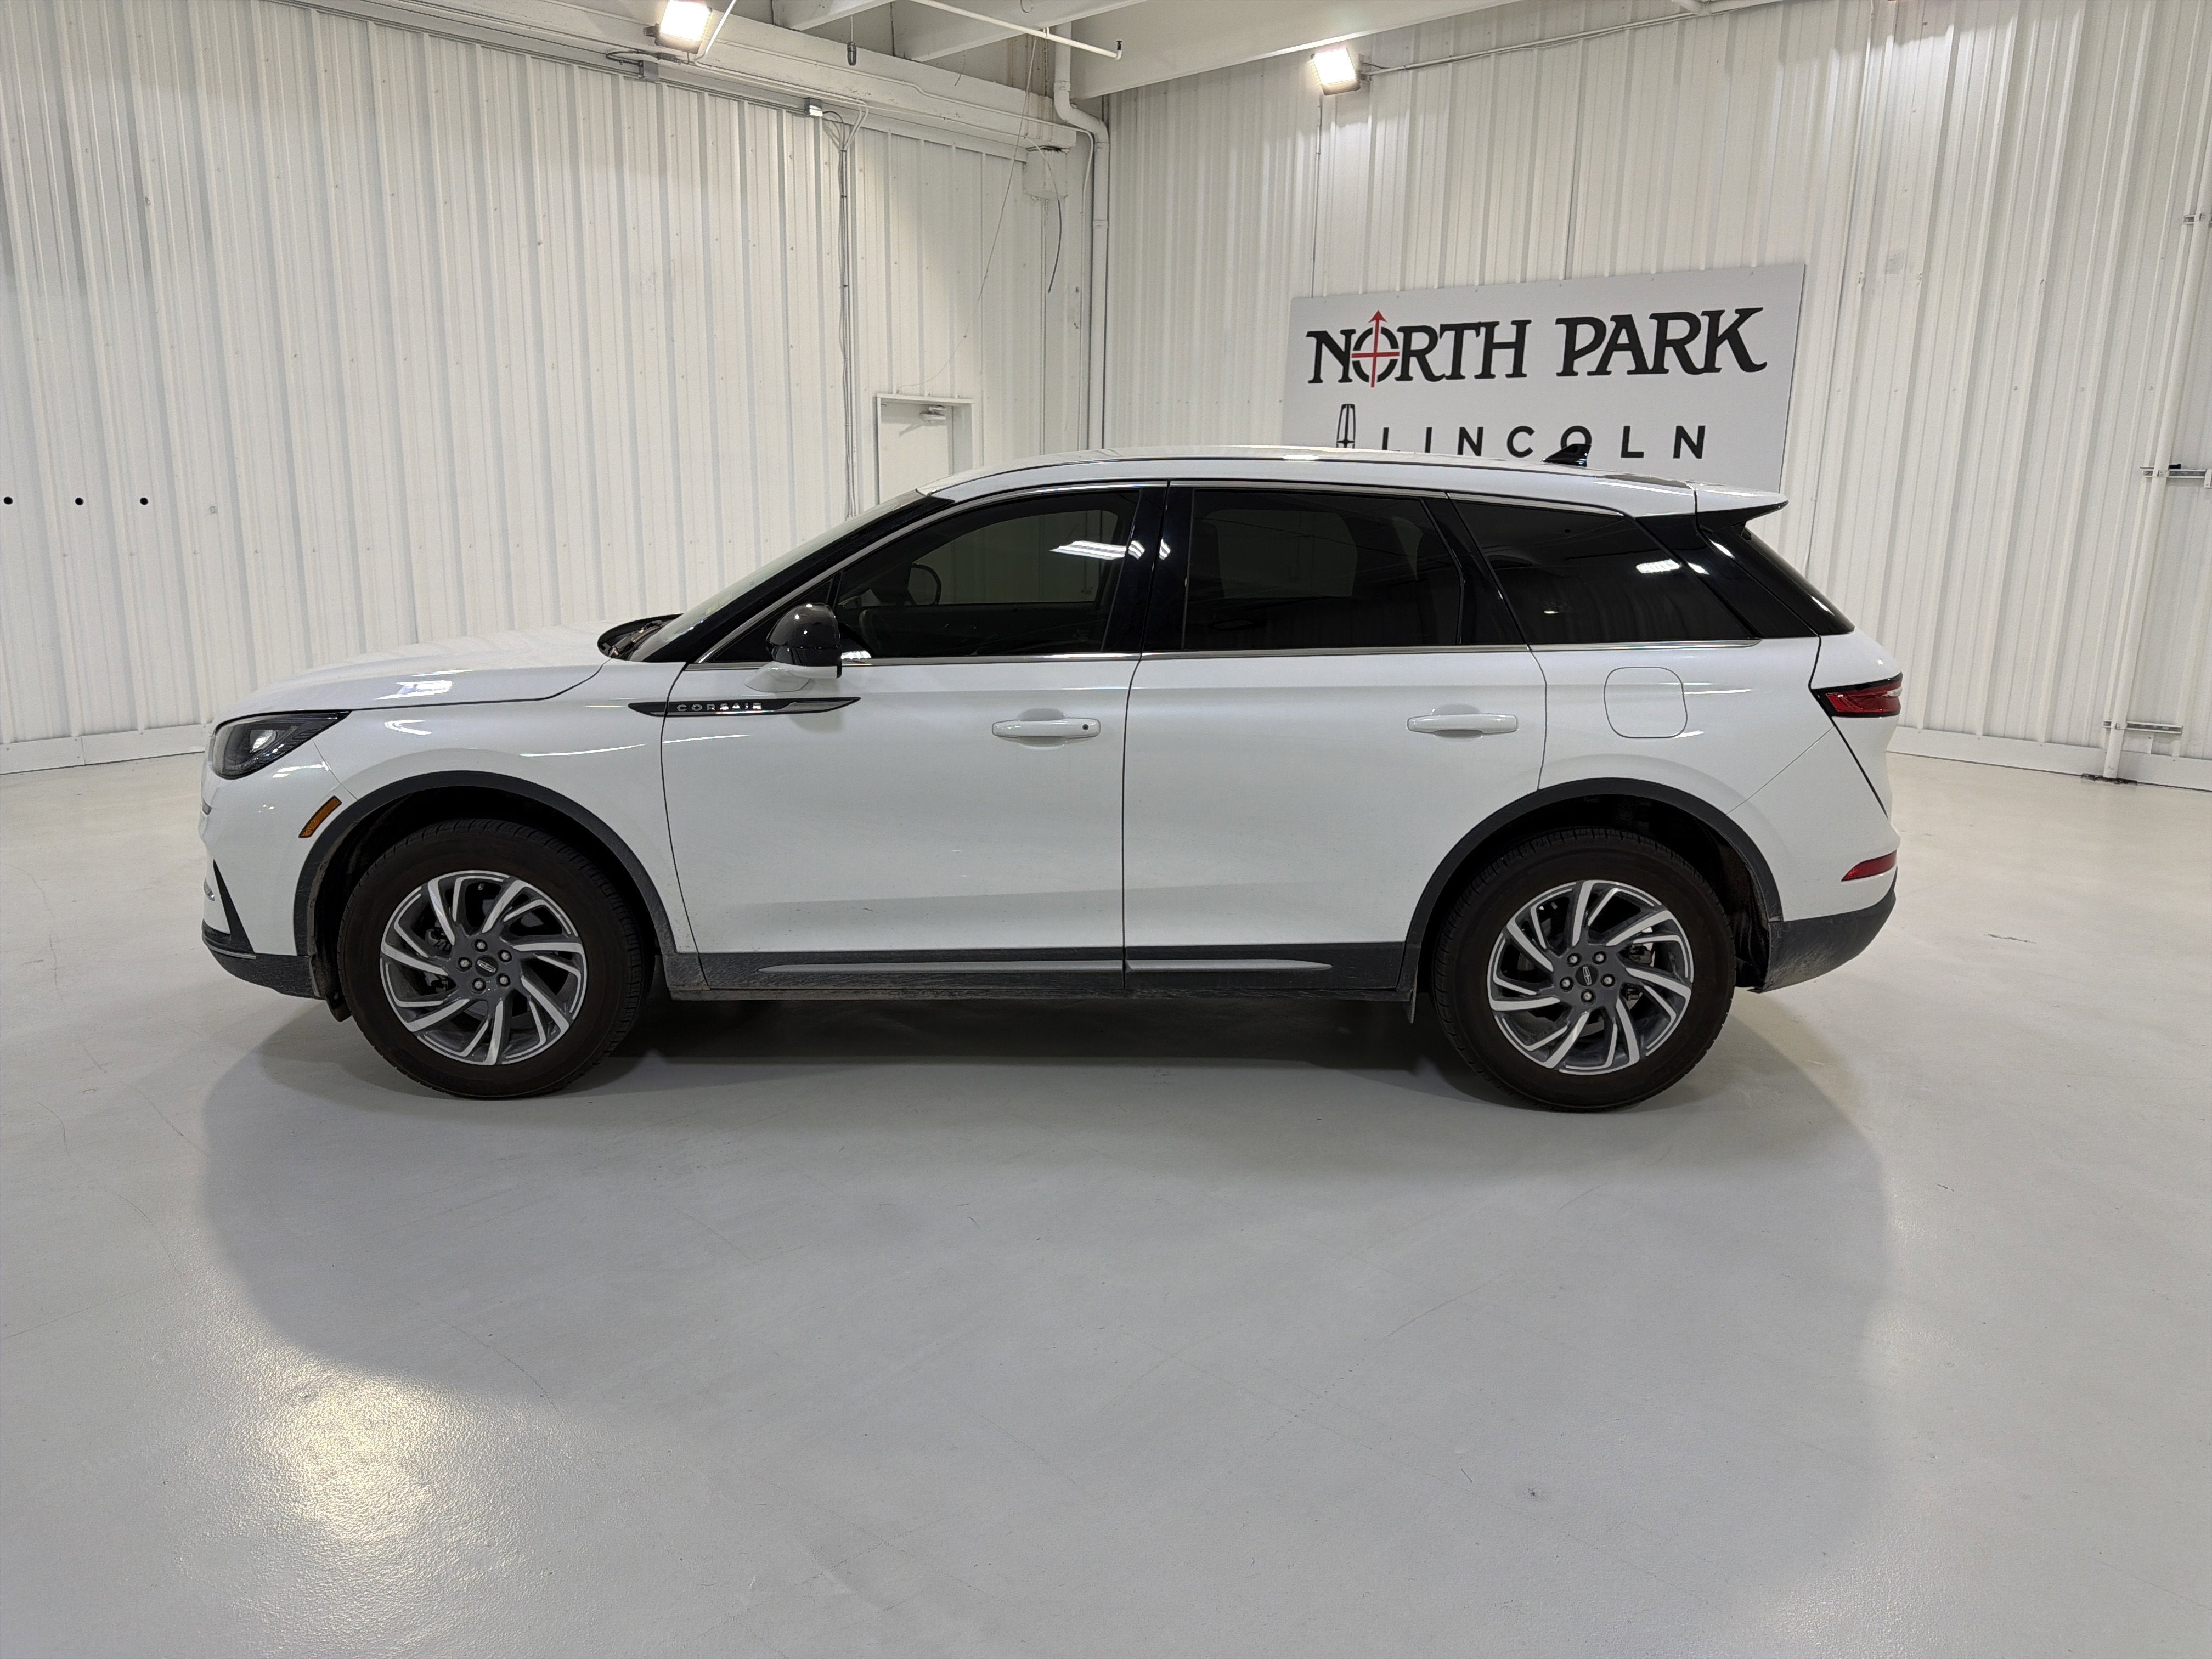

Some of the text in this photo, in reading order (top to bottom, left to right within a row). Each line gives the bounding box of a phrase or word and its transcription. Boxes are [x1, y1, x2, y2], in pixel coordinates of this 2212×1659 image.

[1306, 307, 1767, 384] NORTH PARK
[1381, 425, 1706, 459] LINCOLN
